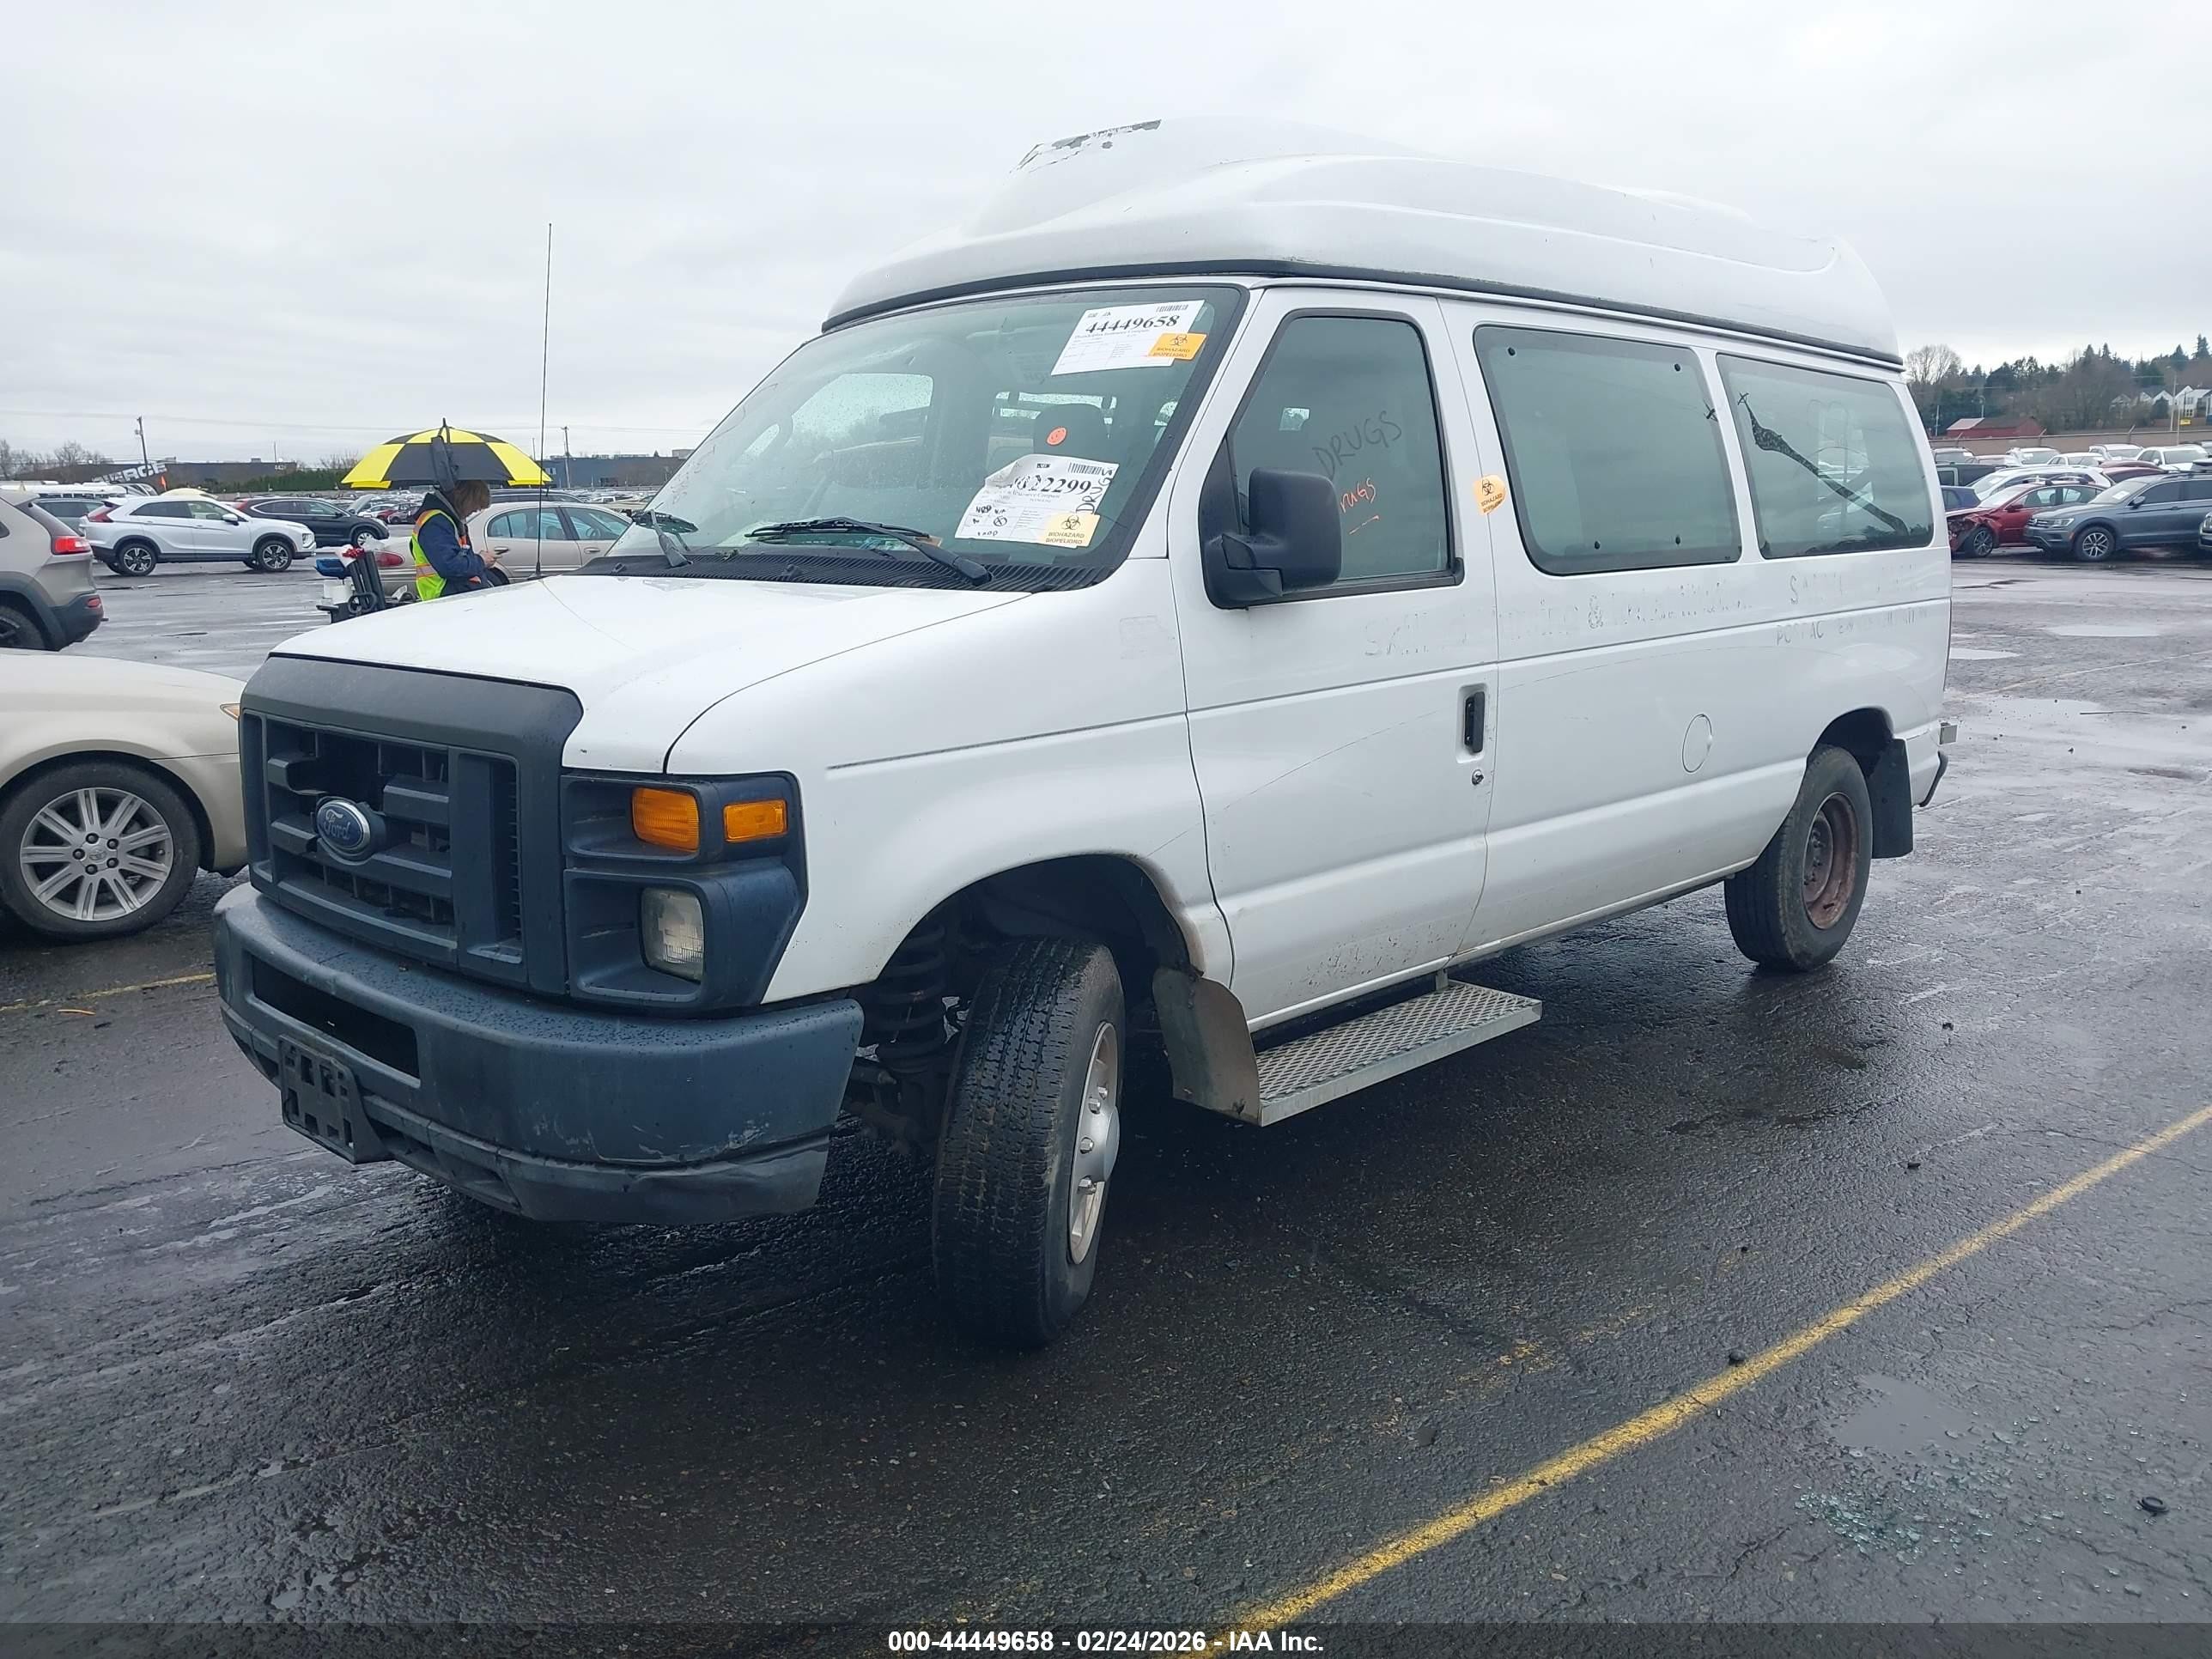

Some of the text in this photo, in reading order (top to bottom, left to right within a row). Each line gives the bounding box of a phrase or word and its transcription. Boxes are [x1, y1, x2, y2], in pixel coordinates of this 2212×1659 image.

[1085, 314, 1180, 334] 44449658
[1311, 410, 1403, 477] DRUGS
[1076, 468, 1113, 515] DRUGS
[323, 808, 352, 841] Ford
